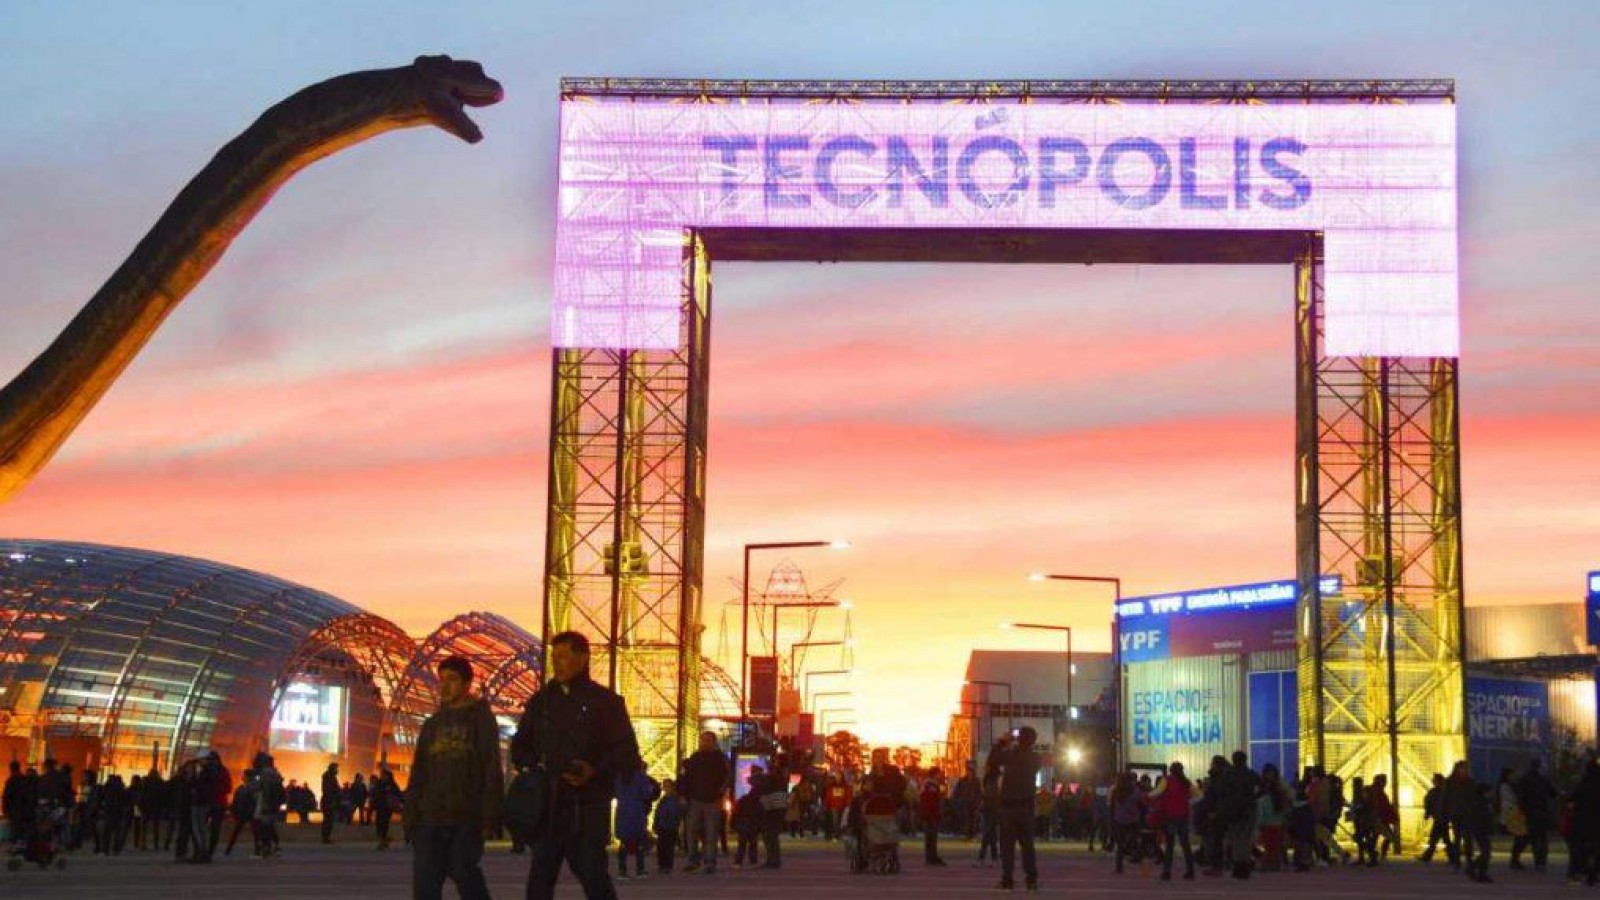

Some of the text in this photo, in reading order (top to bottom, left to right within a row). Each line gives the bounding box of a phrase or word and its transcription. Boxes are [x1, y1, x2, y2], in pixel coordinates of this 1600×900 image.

[701, 108, 1313, 210] TECNÓPOLIS
[1150, 595, 1183, 614] YPF
[1120, 630, 1161, 651] YPF
[1133, 689, 1201, 714] ESPACIO
[1467, 691, 1521, 715] SPACIO
[1468, 708, 1541, 743] NERGÍA
